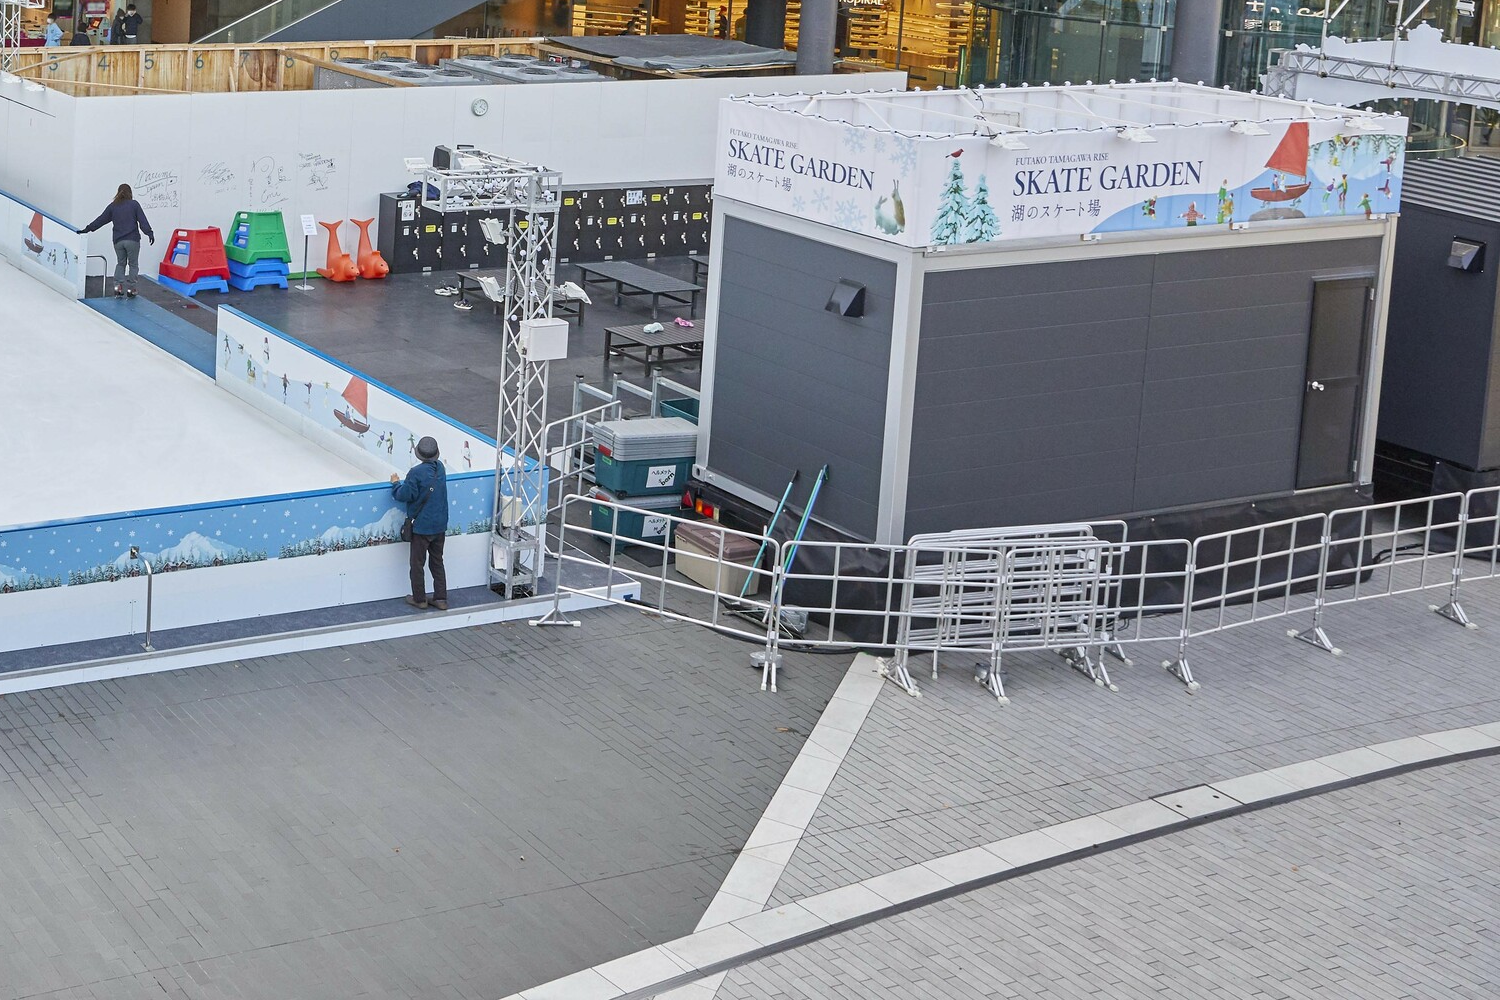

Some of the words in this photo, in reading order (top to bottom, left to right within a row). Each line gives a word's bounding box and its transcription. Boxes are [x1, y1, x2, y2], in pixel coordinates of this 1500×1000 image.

[98, 55, 109, 71] 4
[145, 53, 154, 70] 5
[195, 53, 204, 69] 6
[240, 52, 249, 67] 7
[729, 128, 752, 139] FUTAKO
[752, 133, 785, 147] TAMAGAWA
[785, 140, 798, 149] RISE
[728, 138, 786, 170] SKATE
[790, 153, 875, 191] GARDEN
[1015, 155, 1047, 166] FUTAKO
[1049, 153, 1092, 164] TAMAGAWA
[1093, 152, 1109, 162] RISE
[727, 163, 793, 192] 湖のスケート場
[1013, 166, 1092, 197] SKATE
[1099, 160, 1204, 191] GARDEN
[1011, 199, 1101, 222] 湖のスケート場
